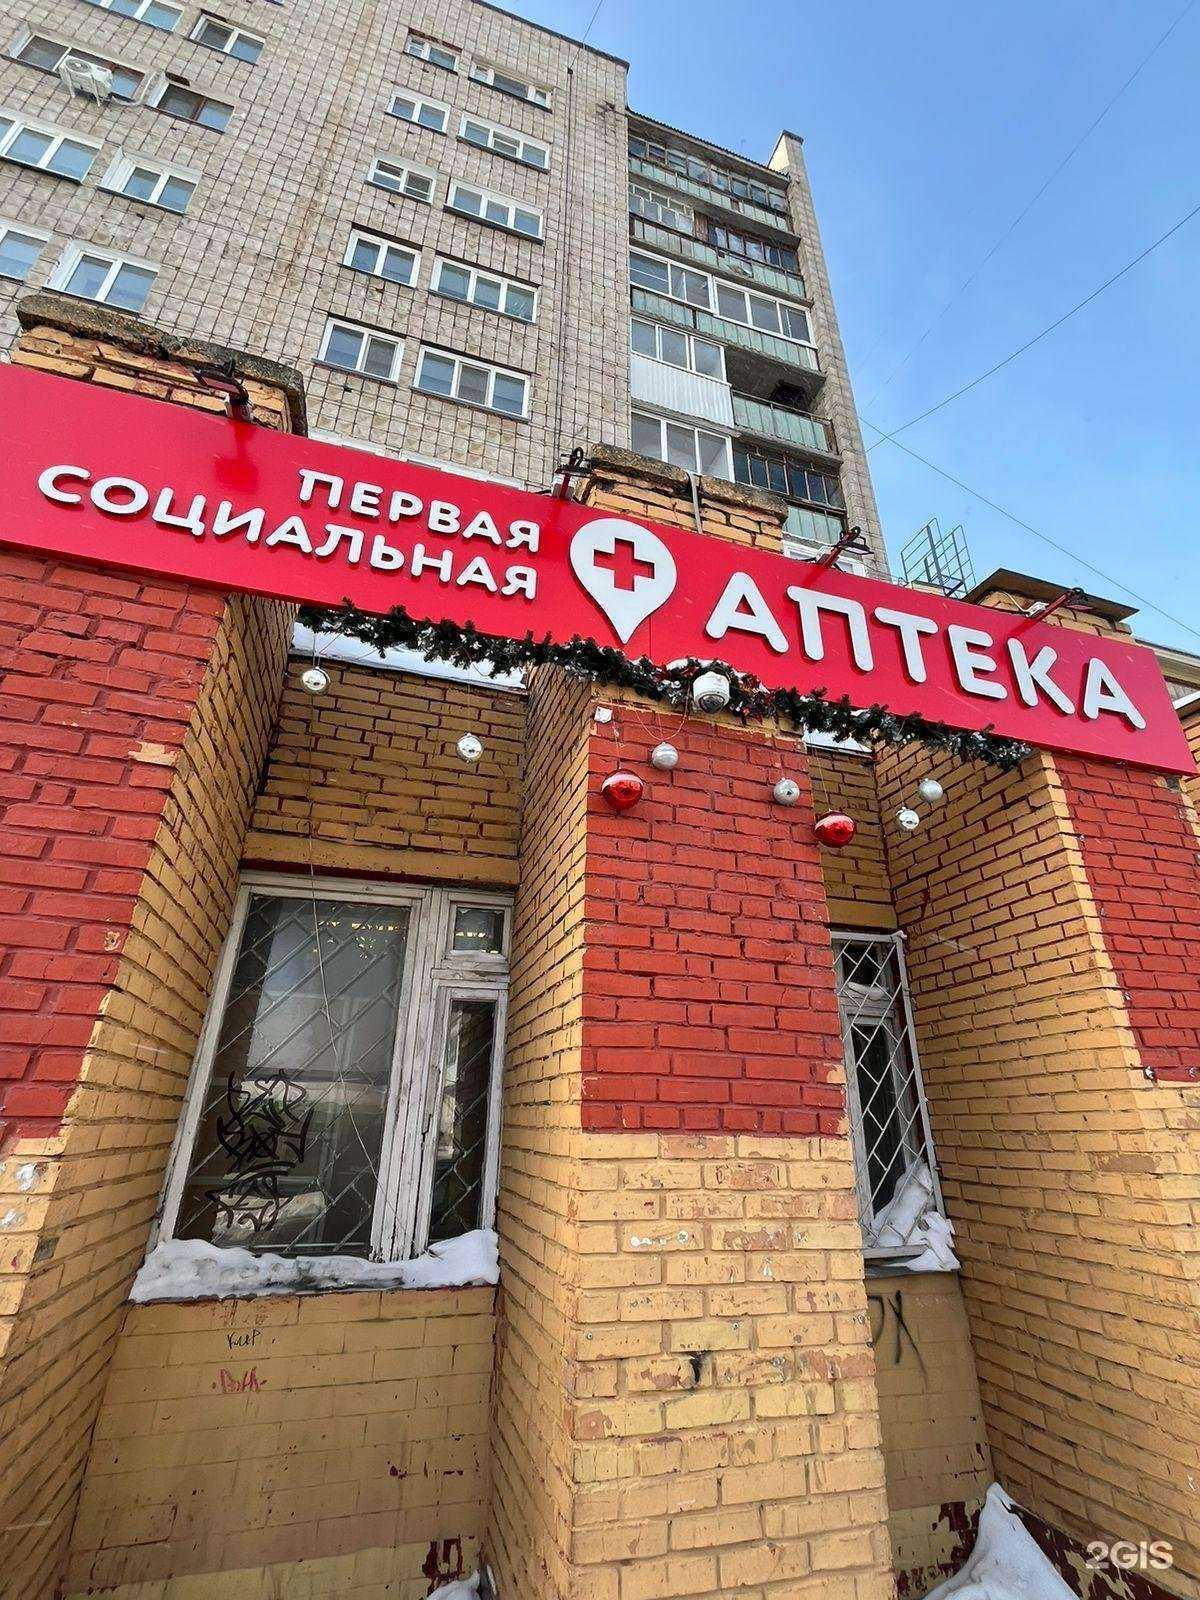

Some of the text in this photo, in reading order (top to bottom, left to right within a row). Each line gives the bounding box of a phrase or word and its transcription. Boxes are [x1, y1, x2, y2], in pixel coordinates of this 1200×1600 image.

[37, 464, 538, 600] СОЦИАЛЬНАЯ
[299, 468, 541, 553] ПЕРВАЯ
[705, 571, 1147, 730] АПТЕКА
